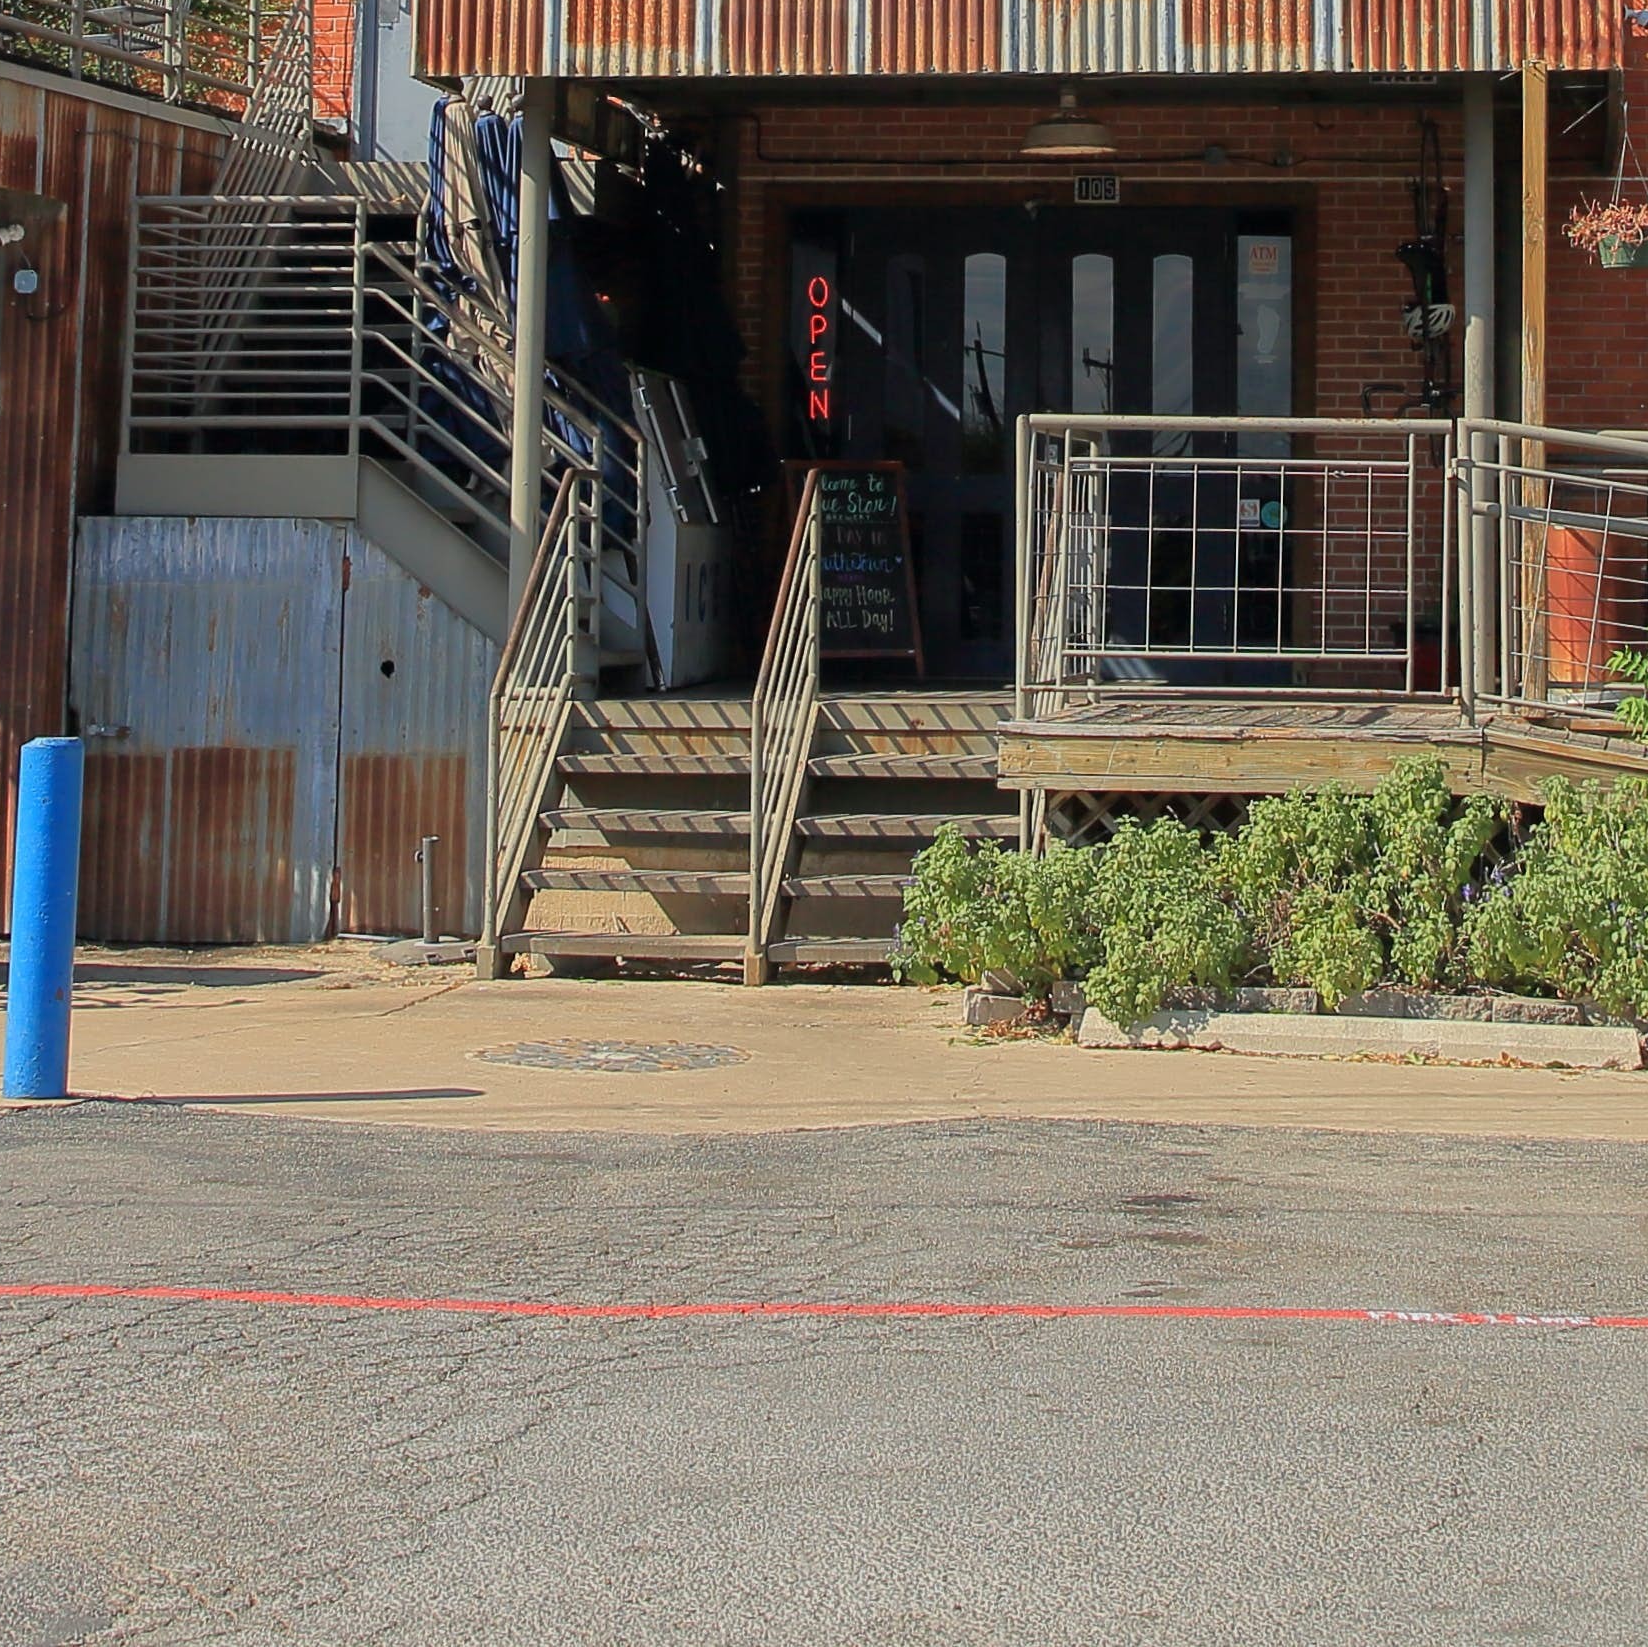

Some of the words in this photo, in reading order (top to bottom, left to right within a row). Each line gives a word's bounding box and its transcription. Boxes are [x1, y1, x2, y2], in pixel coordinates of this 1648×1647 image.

[1081, 179, 1114, 199] 105
[1249, 246, 1277, 261] ATM
[808, 276, 829, 420] OPEN
